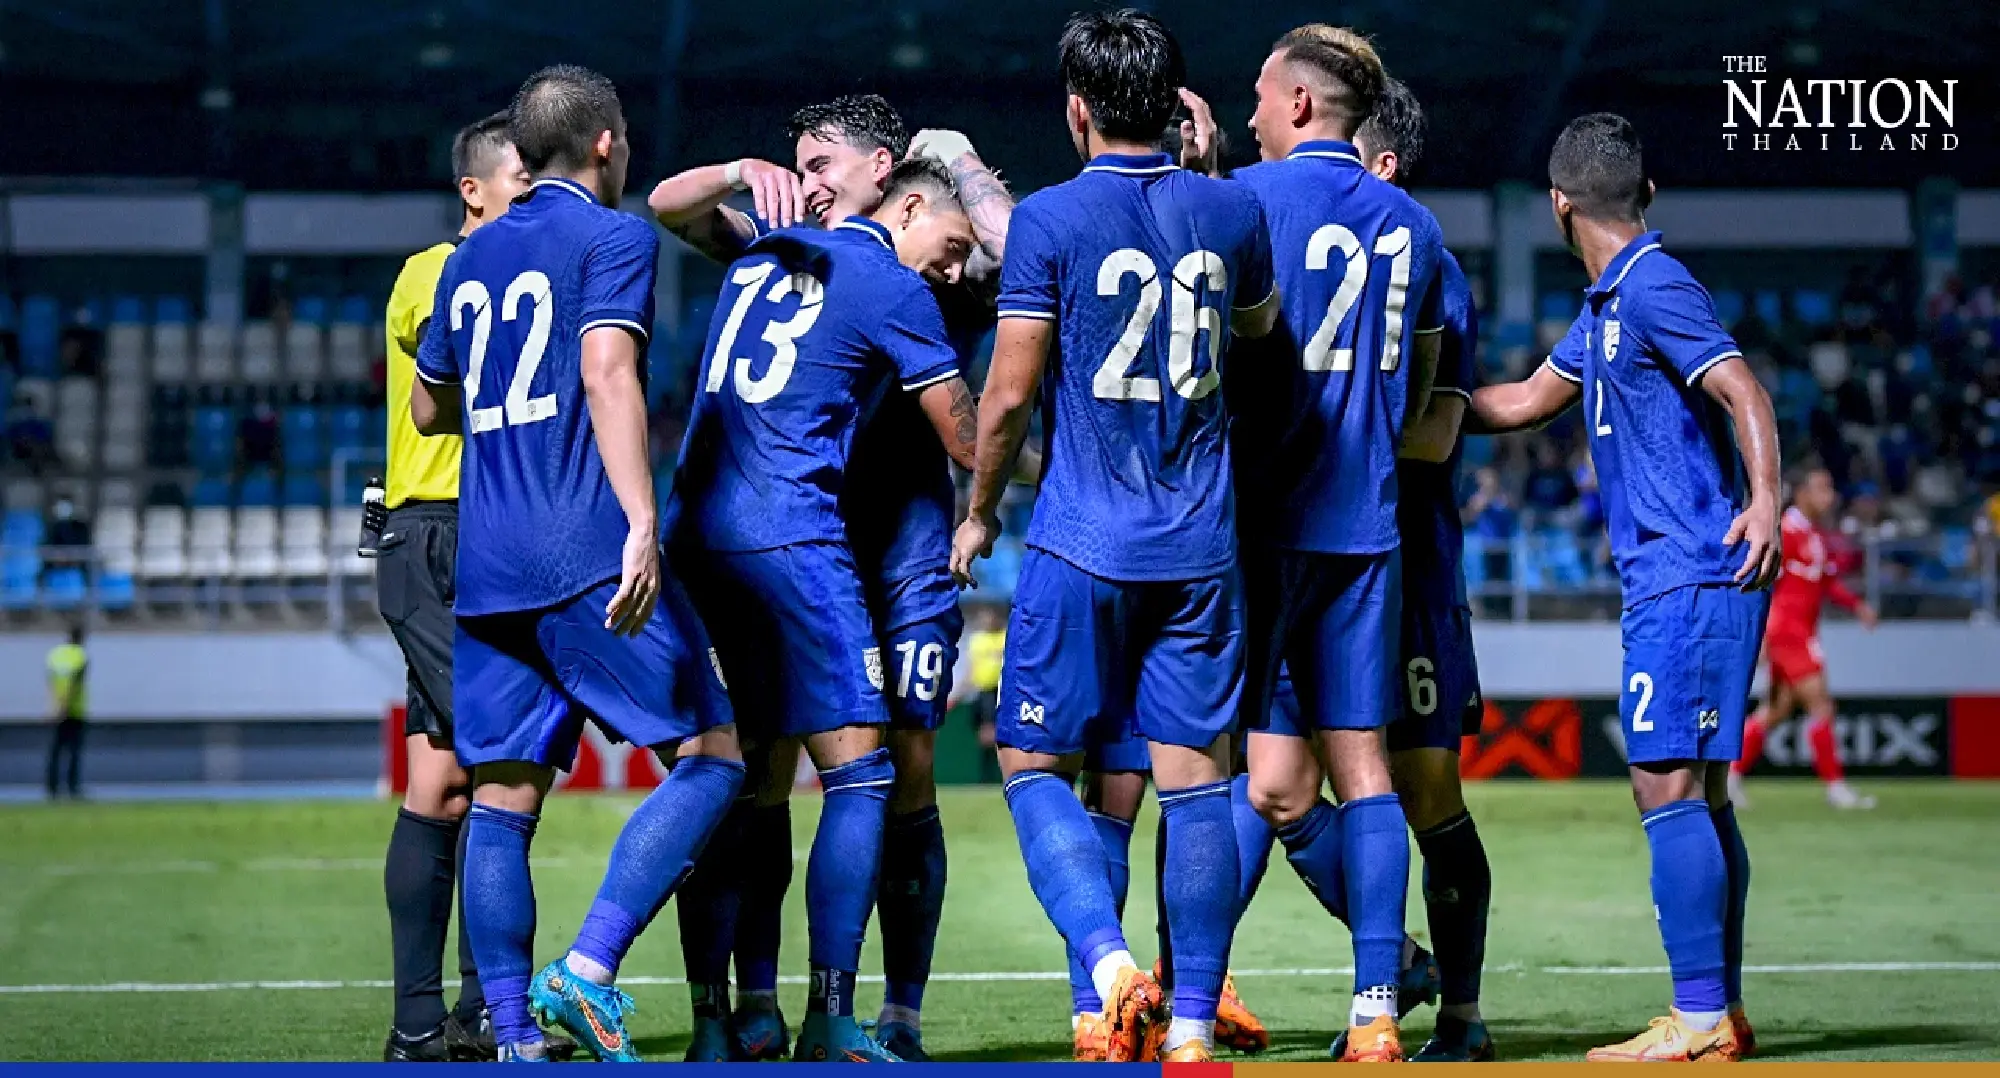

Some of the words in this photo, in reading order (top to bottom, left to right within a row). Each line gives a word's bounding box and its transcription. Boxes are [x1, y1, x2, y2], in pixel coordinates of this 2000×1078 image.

[451, 269, 559, 435] 22
[705, 261, 824, 404] 13
[1092, 247, 1230, 402] 26
[1303, 223, 1413, 372] 21
[895, 640, 943, 701] 19
[1407, 656, 1437, 716] 6
[1629, 671, 1654, 732] 2
